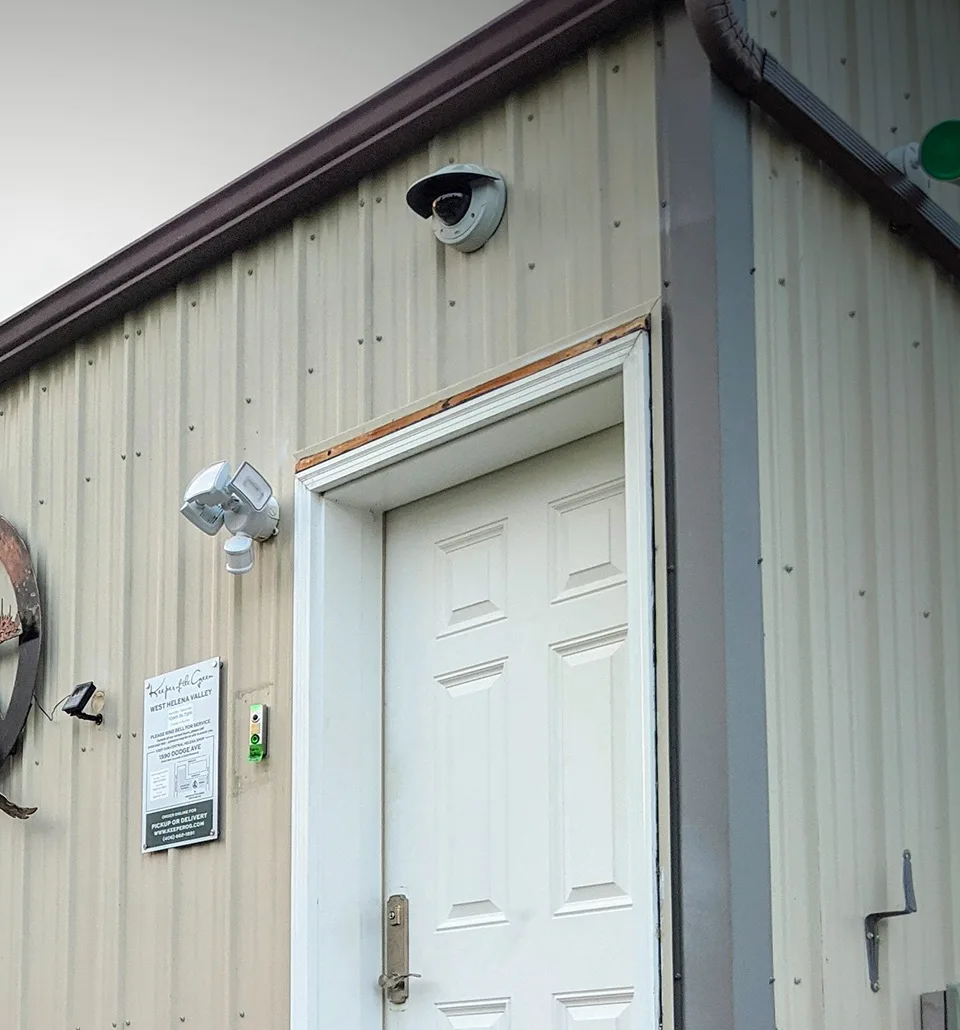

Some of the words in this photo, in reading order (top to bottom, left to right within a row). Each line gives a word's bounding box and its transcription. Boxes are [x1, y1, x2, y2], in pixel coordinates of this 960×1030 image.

[149, 678, 175, 699] Keeper
[191, 669, 214, 688] Green
[150, 702, 166, 713] WEST
[167, 695, 190, 708] HELENA
[190, 688, 212, 701] VALLEY
[150, 732, 164, 740] PLEASE
[194, 719, 210, 727] SERVICE
[171, 747, 191, 757] DODGE
[151, 820, 171, 829] PICKUP
[181, 812, 207, 823] DELIVERY
